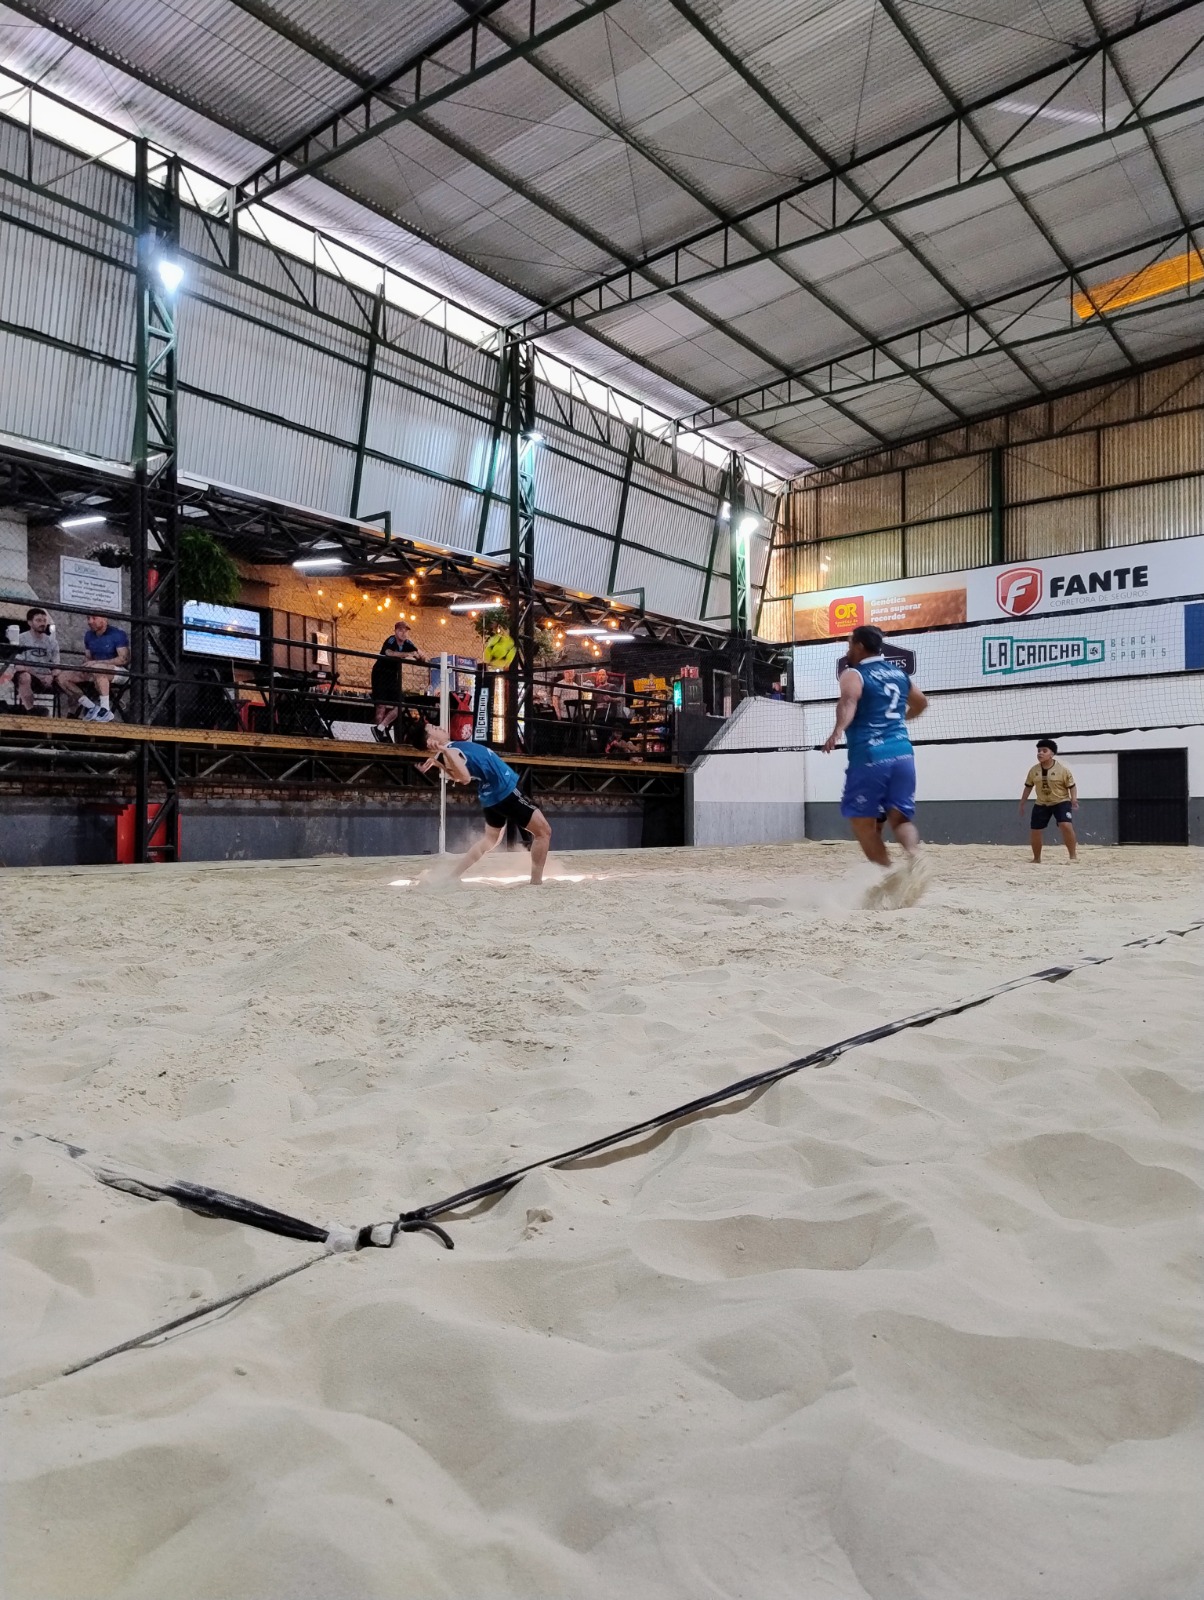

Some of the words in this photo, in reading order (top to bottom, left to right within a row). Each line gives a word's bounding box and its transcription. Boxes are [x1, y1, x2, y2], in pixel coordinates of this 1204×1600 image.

[1050, 565, 1148, 598] FANTE
[870, 597, 906, 607] Genética
[1050, 596, 1096, 607] CORRETORA
[1098, 594, 1108, 602] DE
[1111, 590, 1149, 600] SEGUROS
[834, 602, 858, 619] OR
[870, 608, 889, 616] para
[890, 603, 922, 613] superar
[870, 613, 906, 623] recordes
[1110, 635, 1156, 648] BEACH
[988, 642, 1007, 668] LA
[1016, 644, 1081, 666] CANCHA
[1110, 648, 1166, 661] SPORTS
[884, 682, 901, 719] 2
